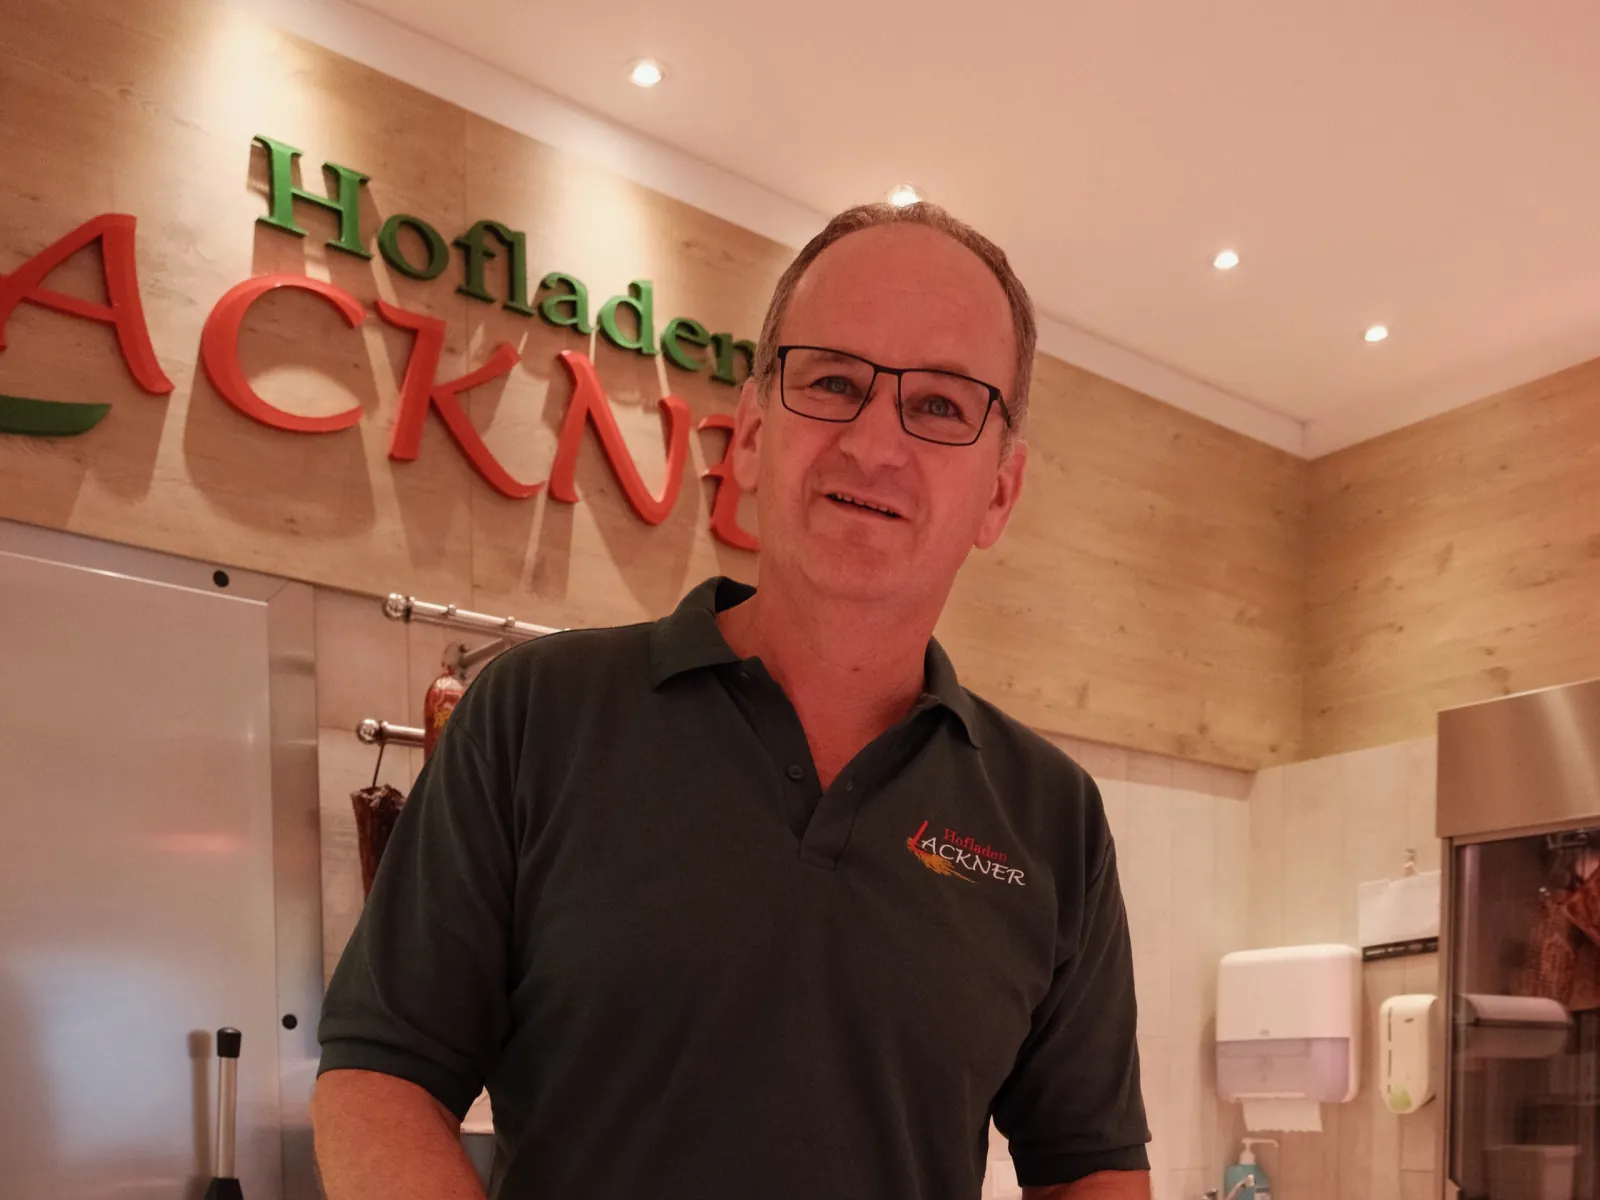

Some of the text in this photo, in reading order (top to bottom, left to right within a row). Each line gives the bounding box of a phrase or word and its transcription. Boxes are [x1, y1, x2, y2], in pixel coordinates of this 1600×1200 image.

[251, 133, 756, 387] Hofladen
[910, 820, 1026, 886] LACKNER
[944, 827, 1008, 863] Hofladen
